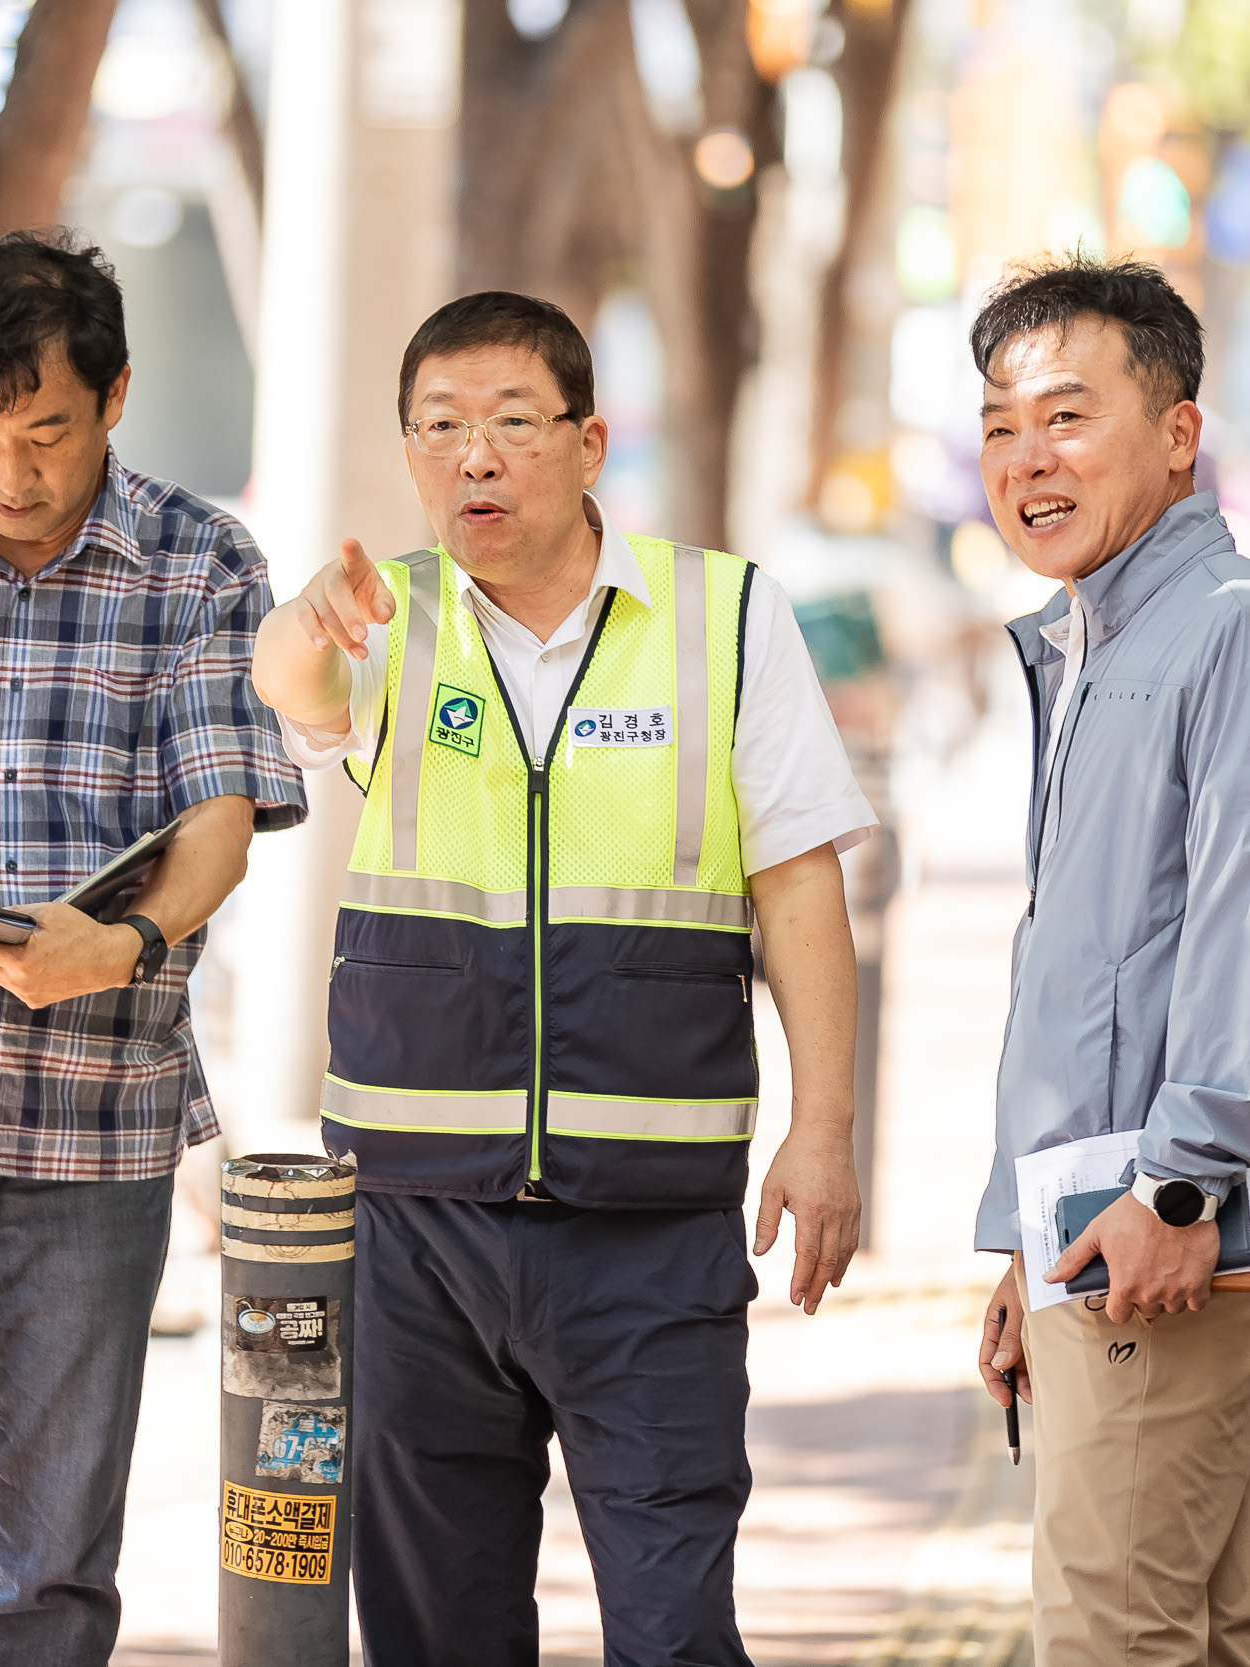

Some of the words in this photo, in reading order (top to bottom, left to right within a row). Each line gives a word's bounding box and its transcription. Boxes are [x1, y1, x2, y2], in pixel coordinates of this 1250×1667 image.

[435, 726, 475, 748] 광진구
[599, 728, 667, 743] 광진구청장
[279, 1318, 323, 1340] 공짜!
[226, 1489, 332, 1531] 휴대폰소액결제
[253, 1528, 298, 1549] 20~200만
[298, 1534, 330, 1550] 즉시입금
